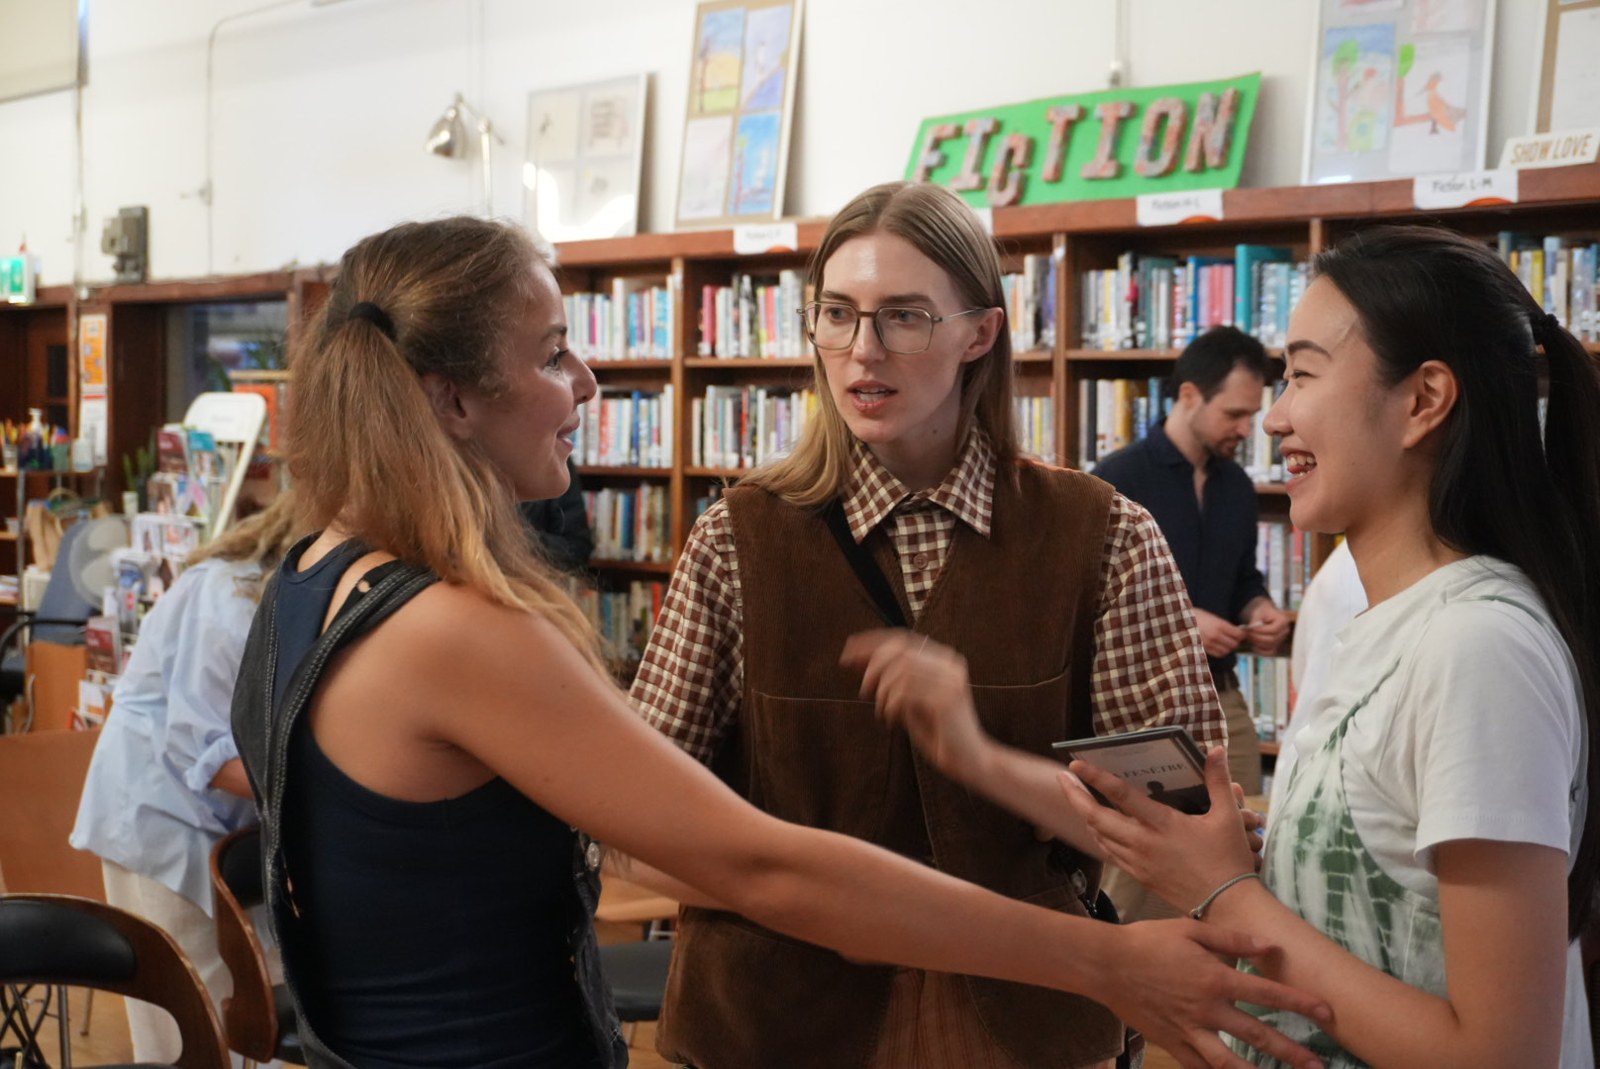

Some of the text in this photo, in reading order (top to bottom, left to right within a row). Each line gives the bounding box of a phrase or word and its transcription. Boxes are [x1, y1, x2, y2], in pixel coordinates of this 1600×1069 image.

[913, 88, 1242, 207] FICTION
[1511, 133, 1592, 165] SHOW LOVE
